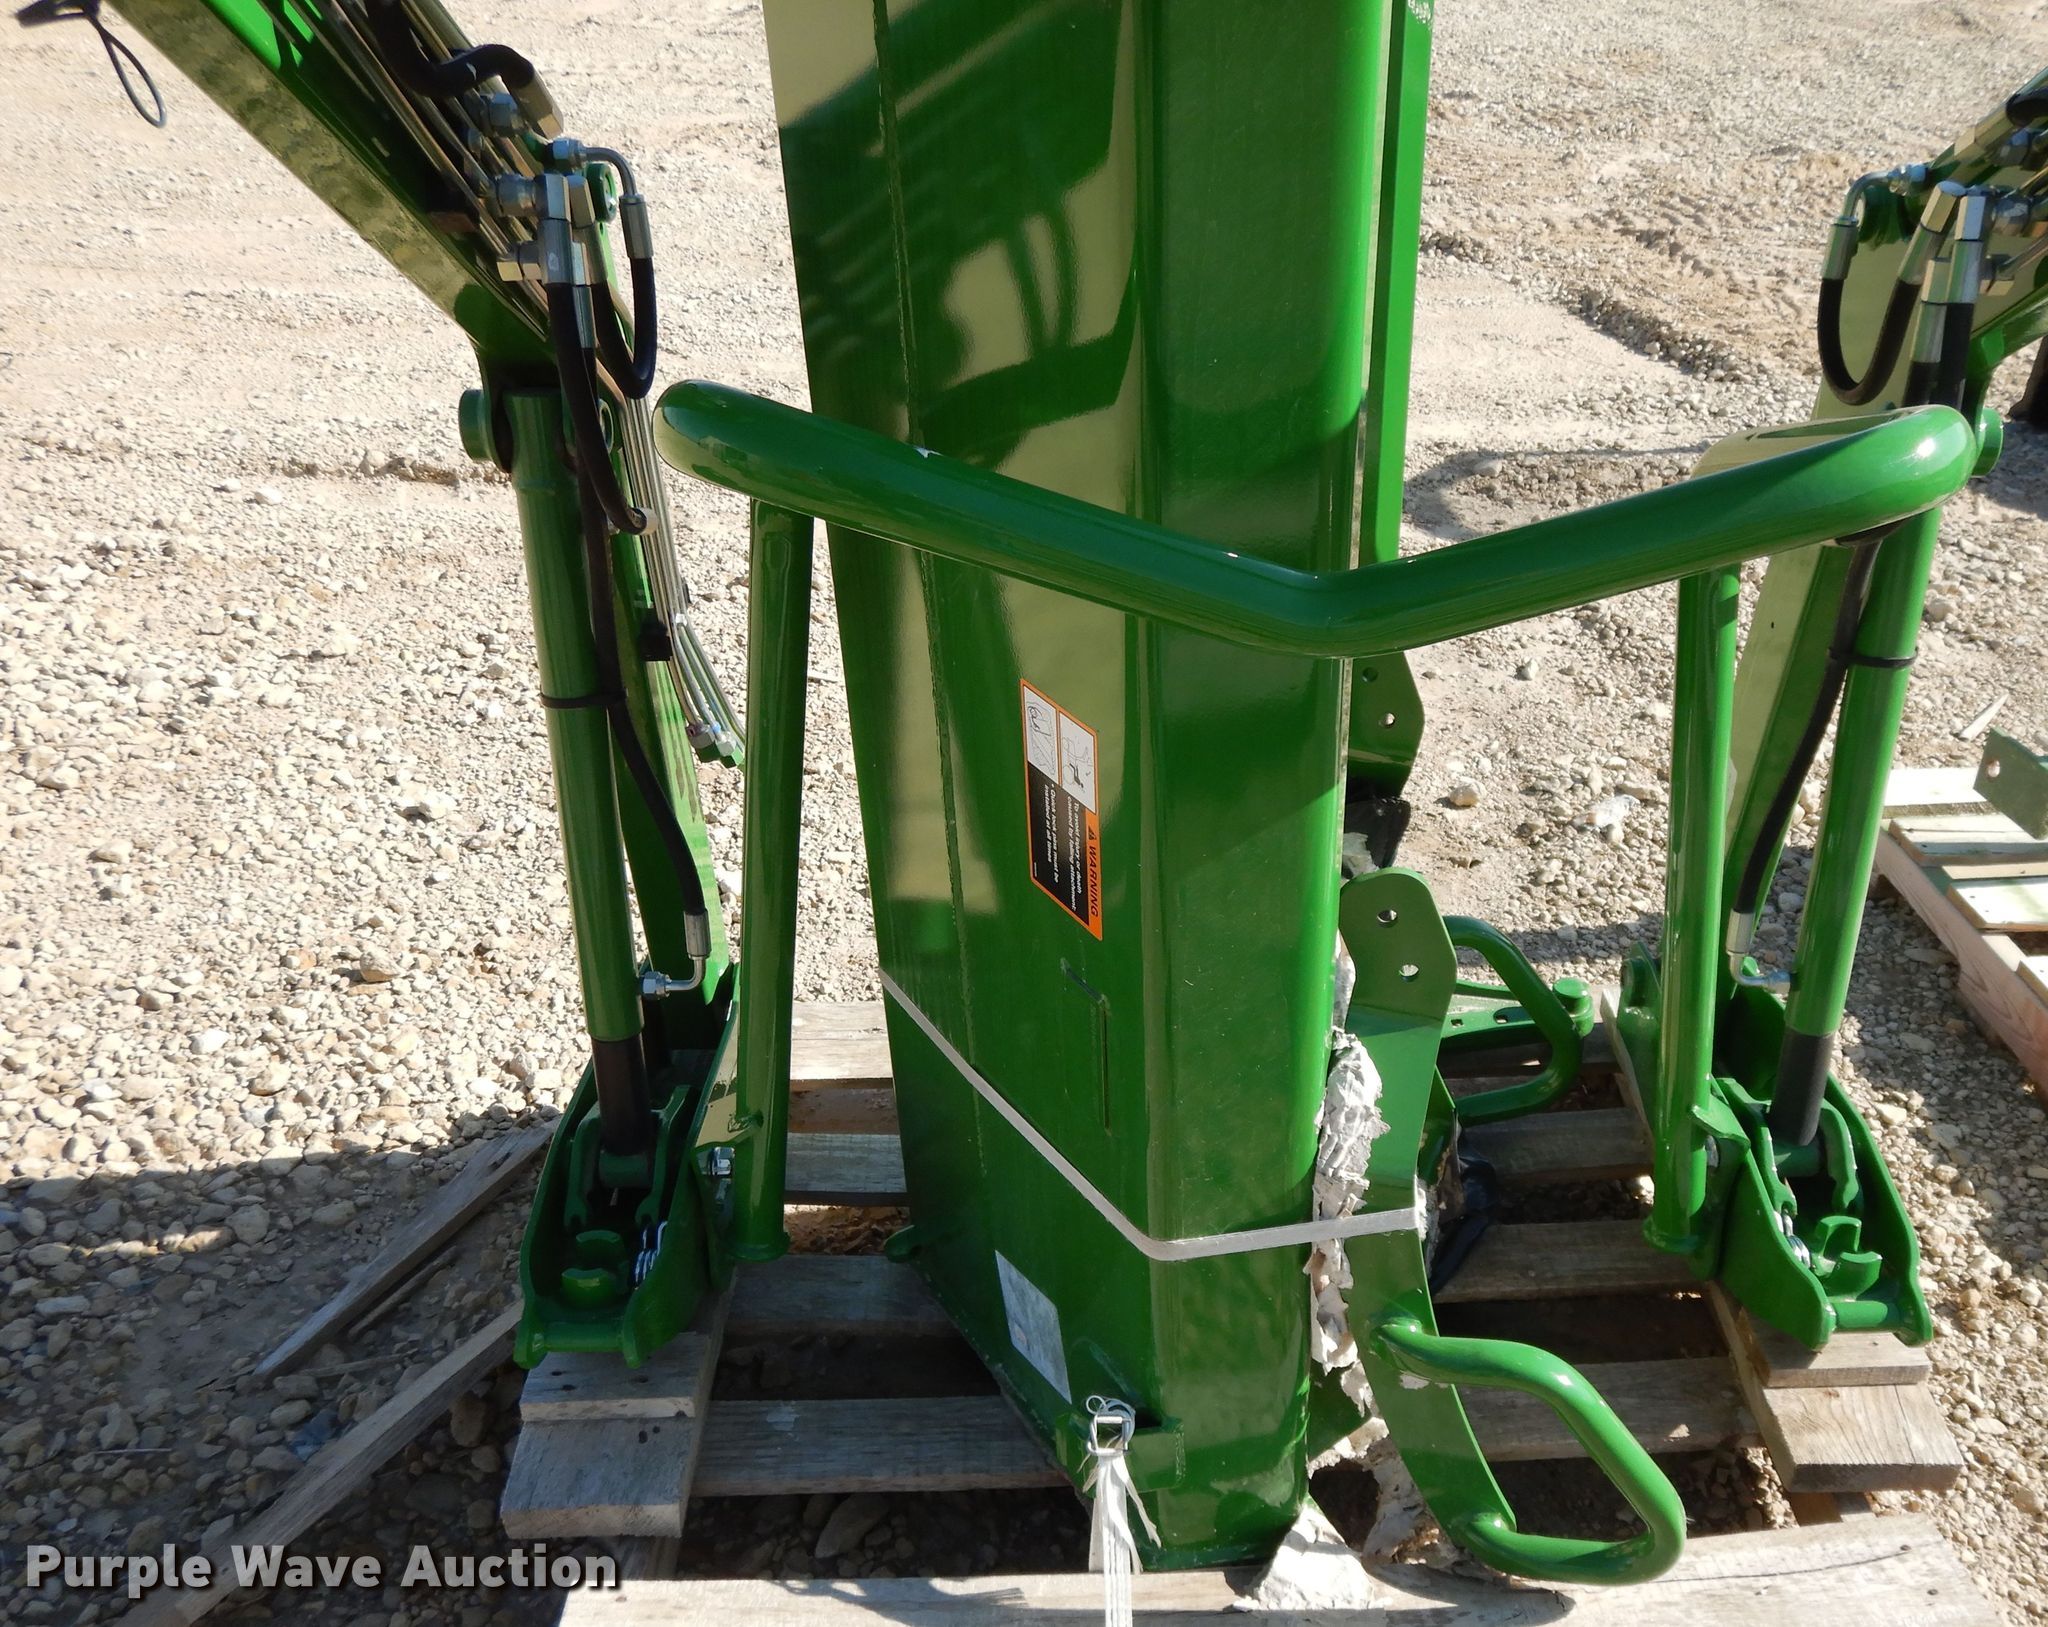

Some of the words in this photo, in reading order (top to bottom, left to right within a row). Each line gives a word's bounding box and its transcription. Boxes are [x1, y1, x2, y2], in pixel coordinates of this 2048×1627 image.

[1074, 803, 1080, 812] To
[1068, 828, 1074, 839] by
[1054, 872, 1059, 883] be
[1089, 846, 1098, 917] WARNING
